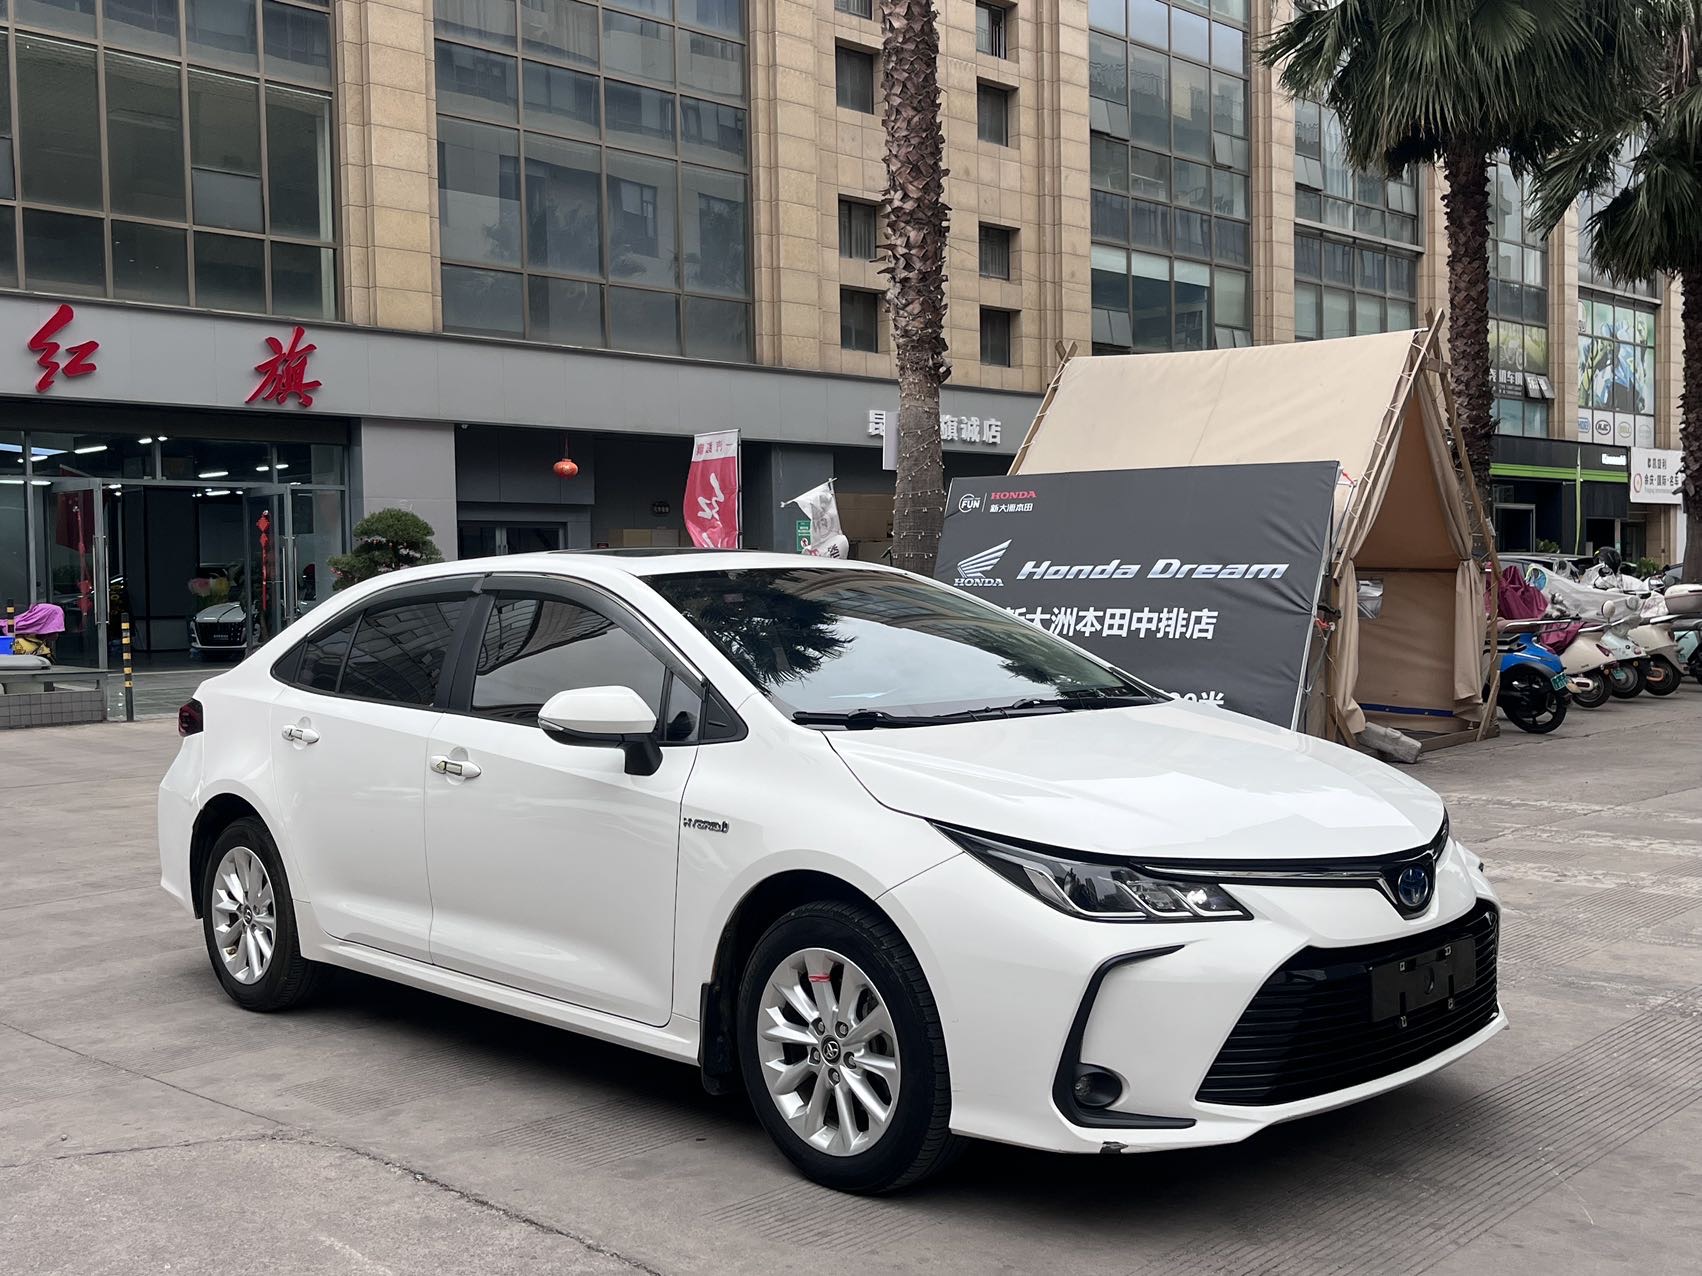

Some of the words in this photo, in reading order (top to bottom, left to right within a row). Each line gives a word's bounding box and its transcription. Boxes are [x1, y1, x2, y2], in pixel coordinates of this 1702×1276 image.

[28, 304, 321, 408] 红旗
[991, 491, 1037, 500] HONDA
[961, 500, 981, 509] FUN
[989, 503, 1034, 513] 新大洲本田
[1016, 559, 1142, 580] Honda
[1146, 558, 1290, 580] Dream
[953, 577, 1004, 587] HONDA
